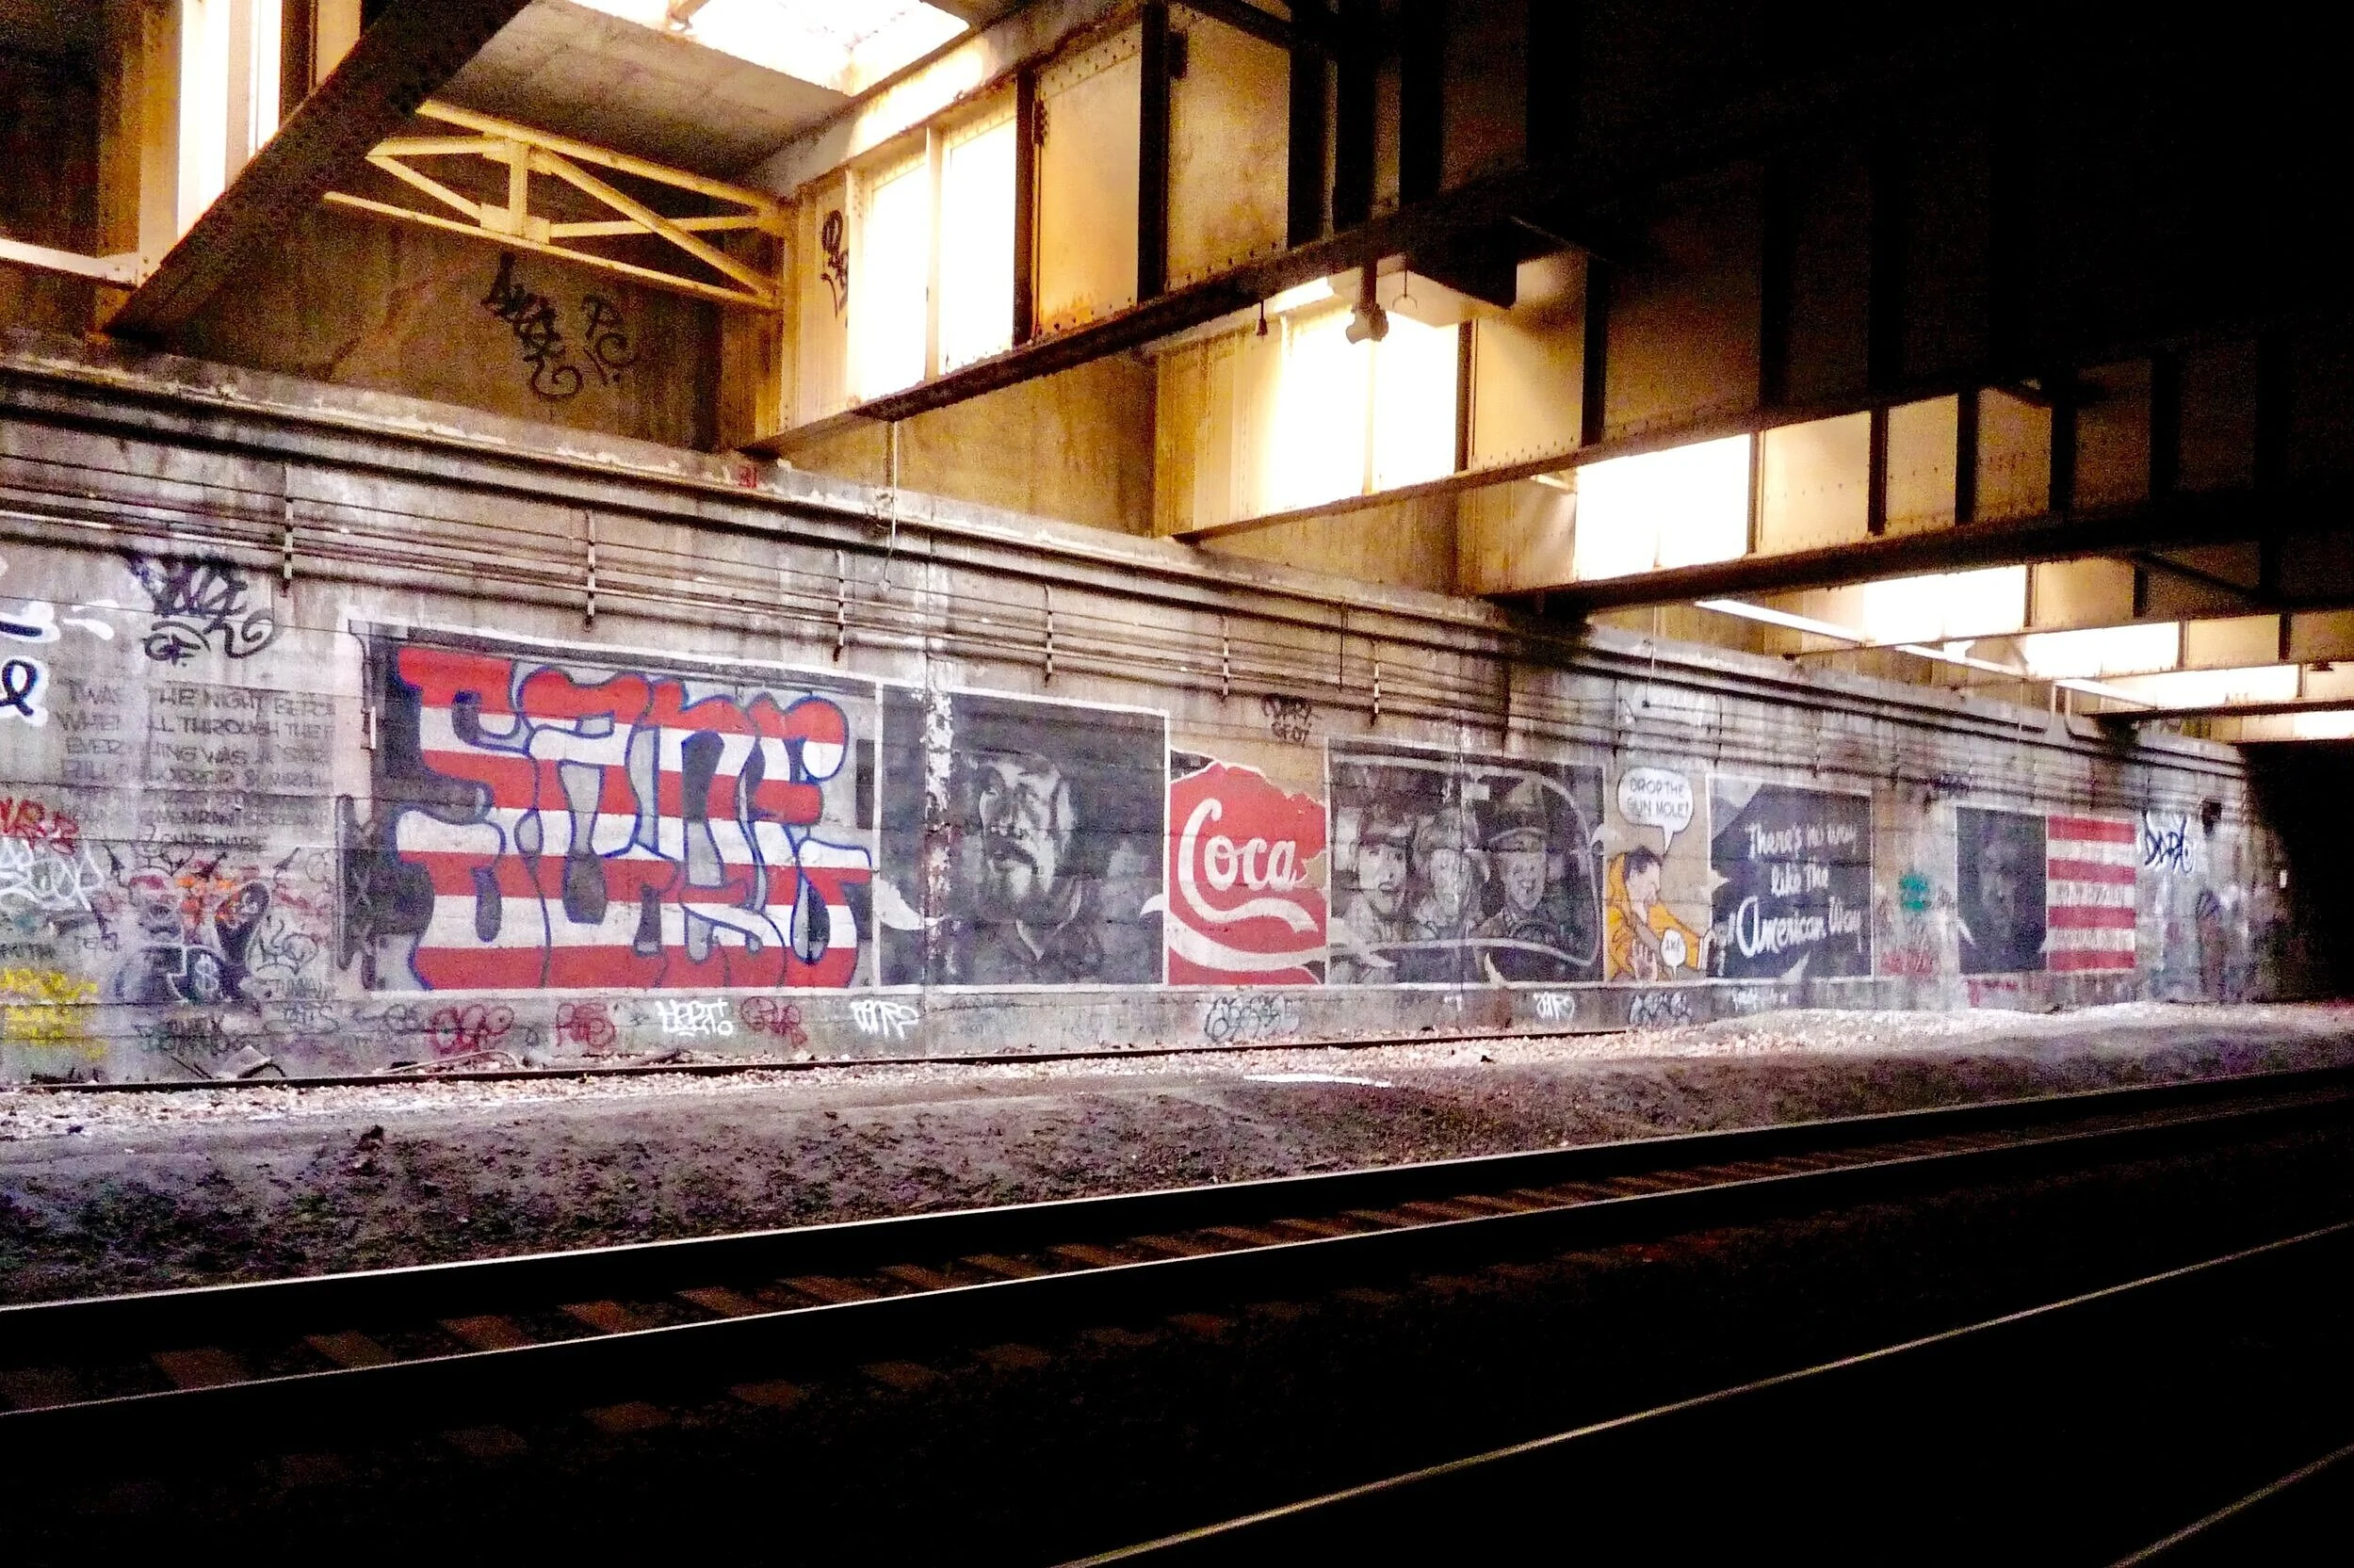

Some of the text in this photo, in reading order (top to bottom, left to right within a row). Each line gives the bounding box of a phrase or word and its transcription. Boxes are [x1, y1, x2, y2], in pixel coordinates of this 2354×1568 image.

[1629, 777, 1685, 798] DROP THE
[1177, 797, 1319, 934] Coca
[1736, 895, 1827, 959] American
